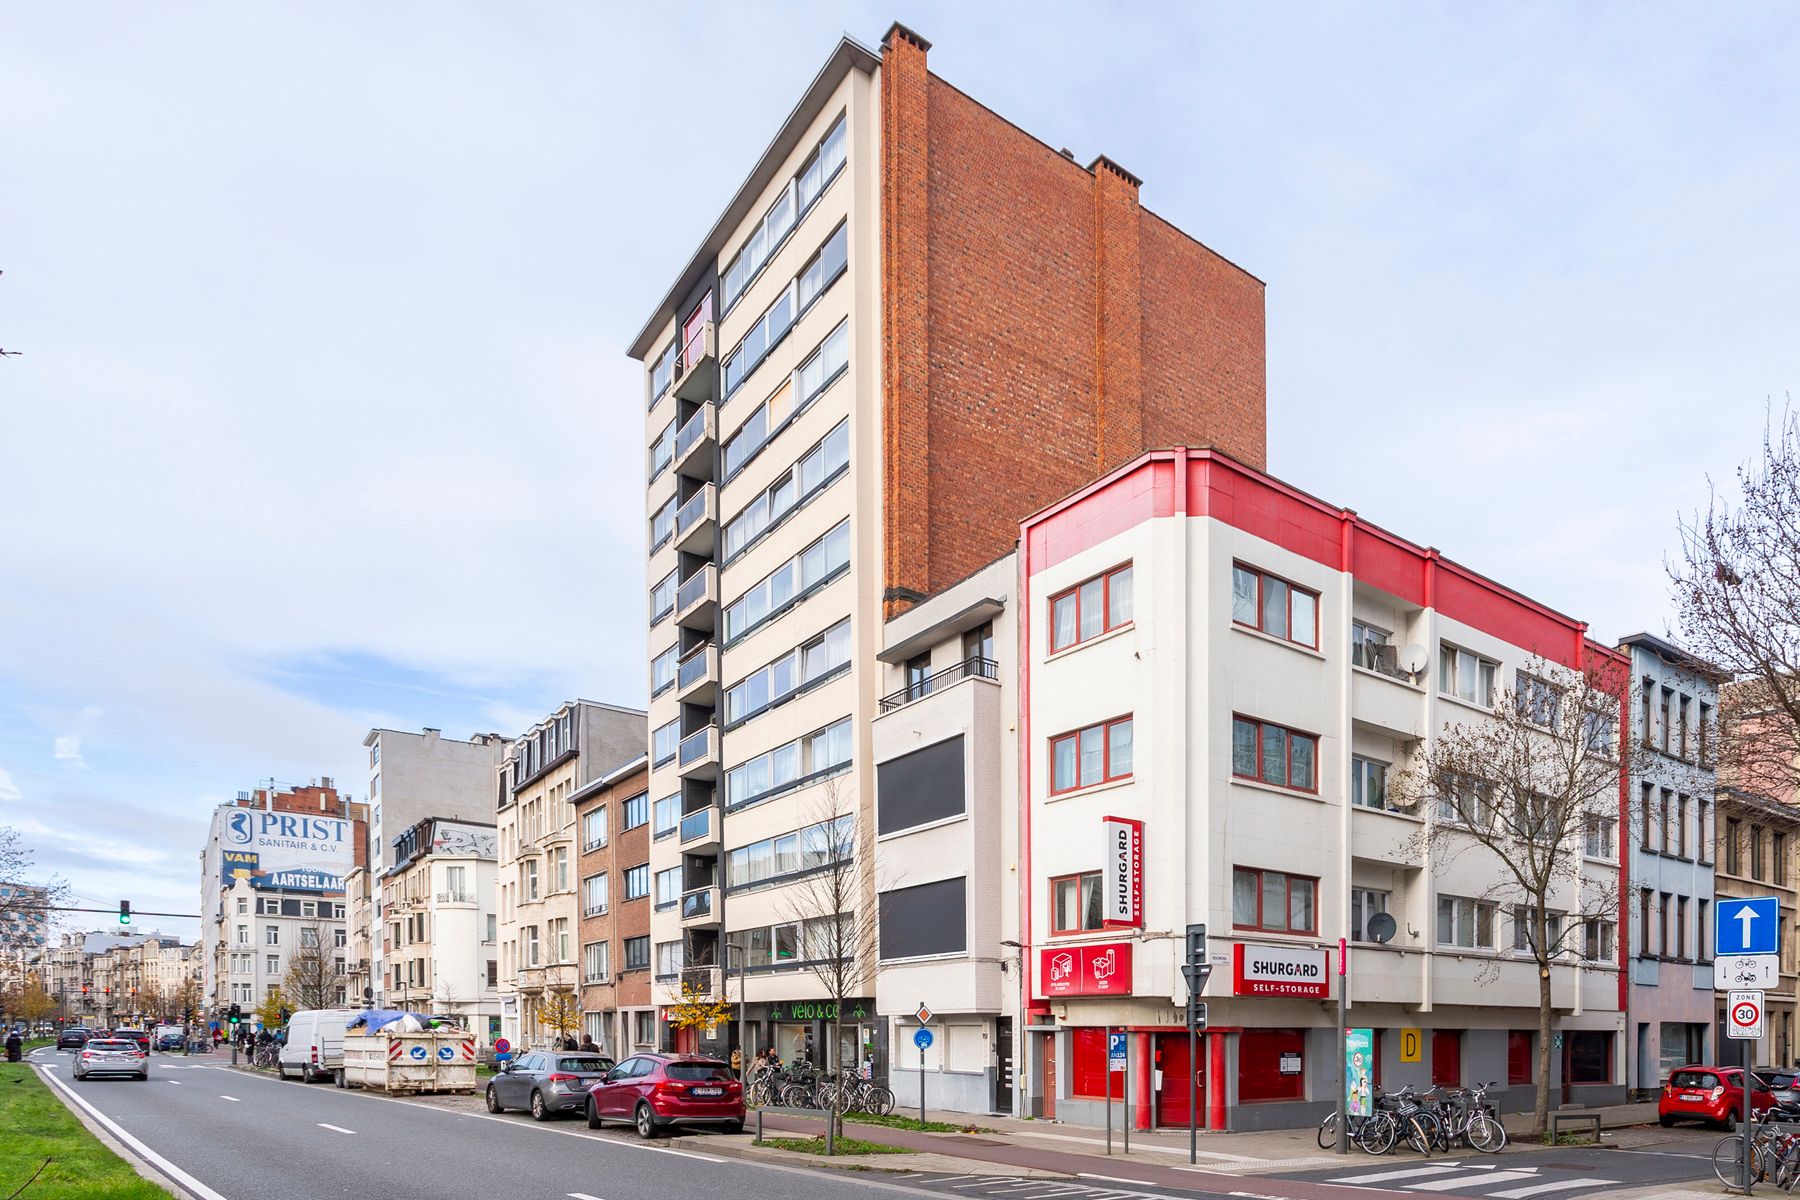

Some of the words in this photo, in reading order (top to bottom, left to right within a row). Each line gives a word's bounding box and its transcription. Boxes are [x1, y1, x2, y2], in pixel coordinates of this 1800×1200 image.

[260, 813, 348, 841] PRIST
[258, 838, 308, 850] SANITAIR
[1118, 829, 1128, 915] SHURGARD
[272, 873, 345, 889] AARTSELAAR
[1252, 960, 1318, 977] SHURGARD
[1253, 983, 1320, 994] SELF-STORAGE
[816, 1005, 824, 1018] &
[1738, 1010, 1753, 1019] 30
[1111, 1035, 1119, 1050] P
[1406, 1033, 1415, 1056] D
